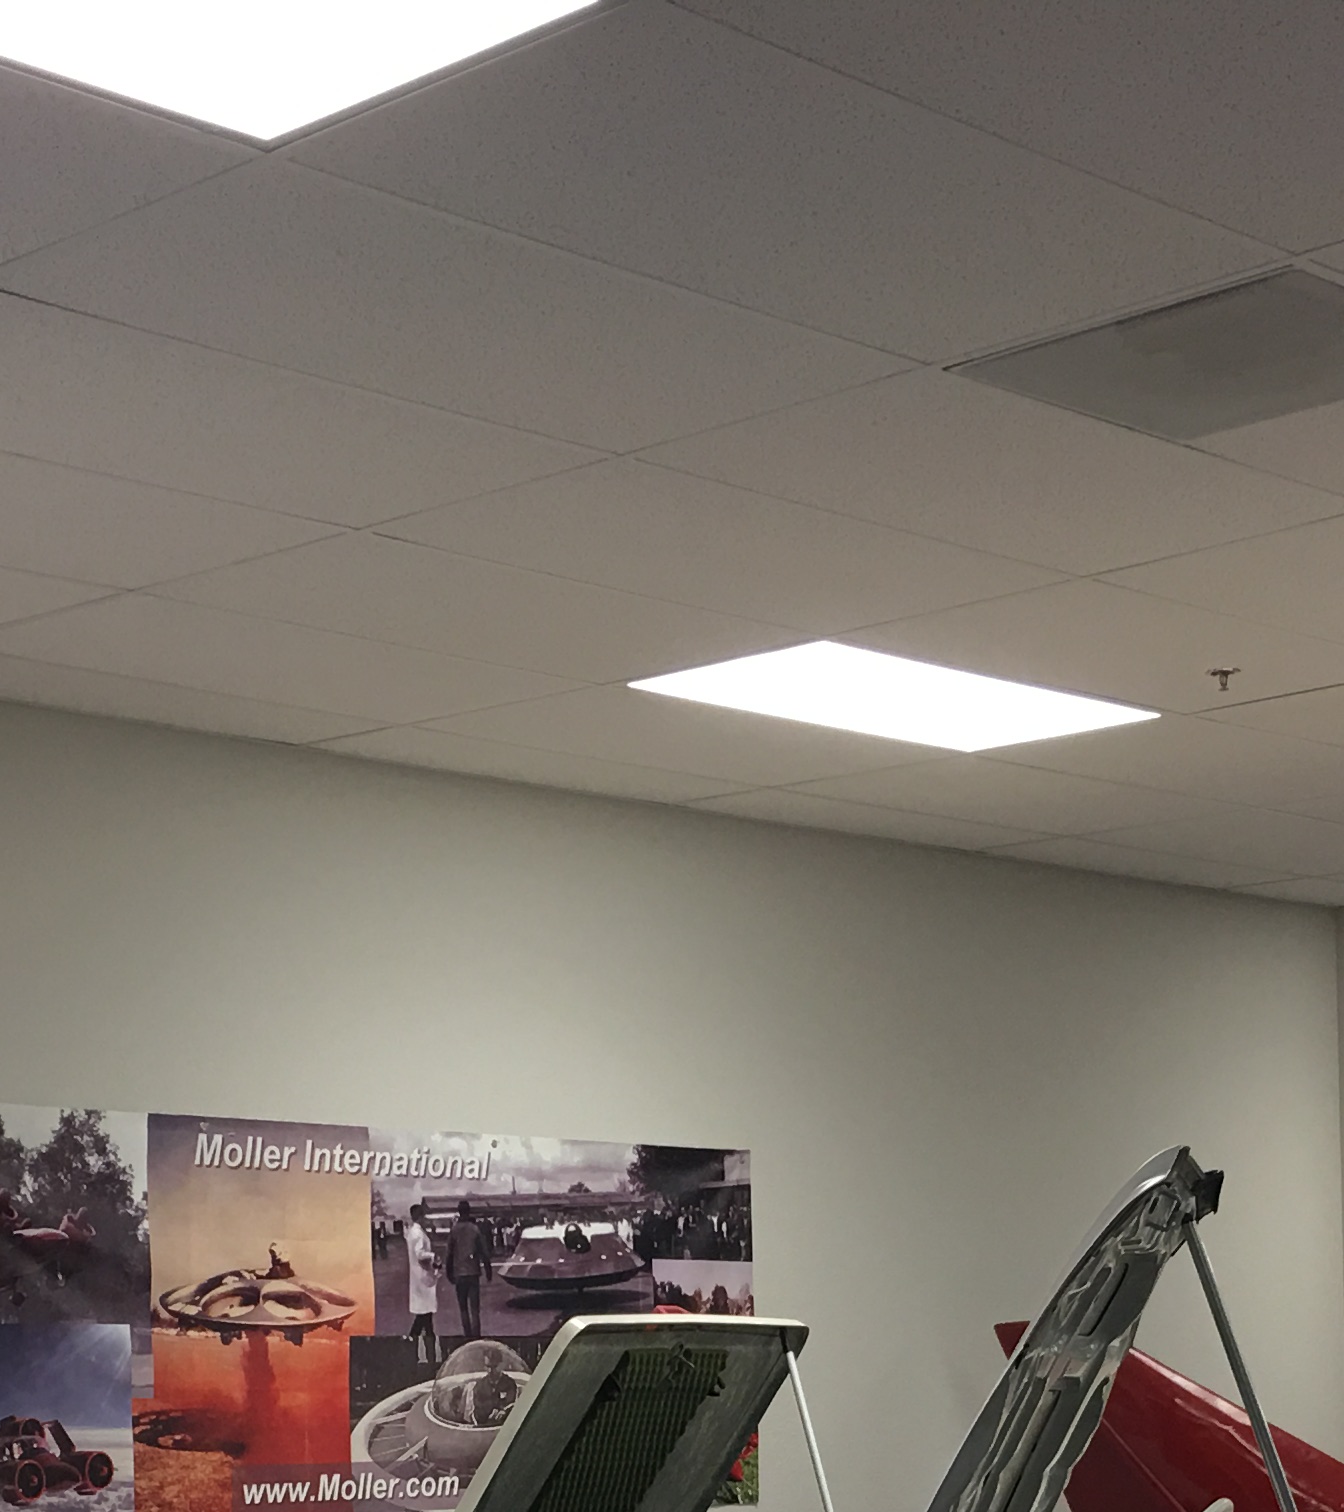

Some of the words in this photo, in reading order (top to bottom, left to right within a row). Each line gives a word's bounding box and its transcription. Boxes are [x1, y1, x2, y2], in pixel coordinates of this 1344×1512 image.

[193, 1131, 296, 1172] Moller
[303, 1136, 492, 1181] International
[242, 1469, 461, 1506] www.Moller.com
